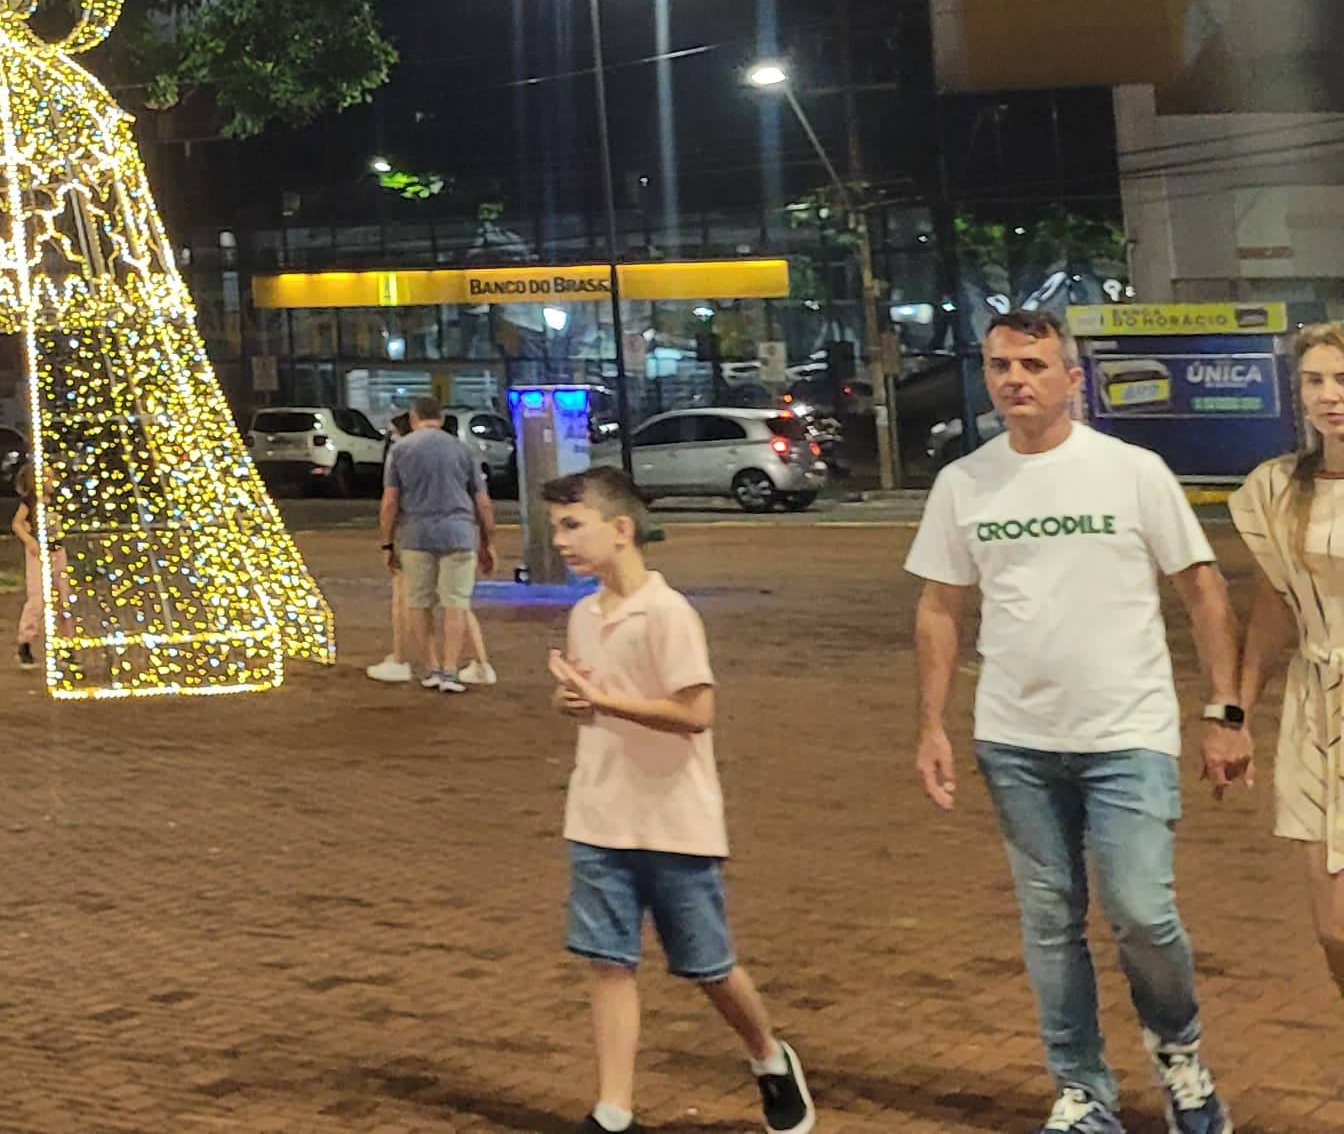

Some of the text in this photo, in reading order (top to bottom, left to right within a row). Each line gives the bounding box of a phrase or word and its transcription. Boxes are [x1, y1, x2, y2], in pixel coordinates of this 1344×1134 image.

[469, 279, 526, 295] BANCO
[529, 279, 551, 294] DO
[1186, 361, 1263, 384] ÚNICA
[977, 515, 1116, 542] CROCODILE
